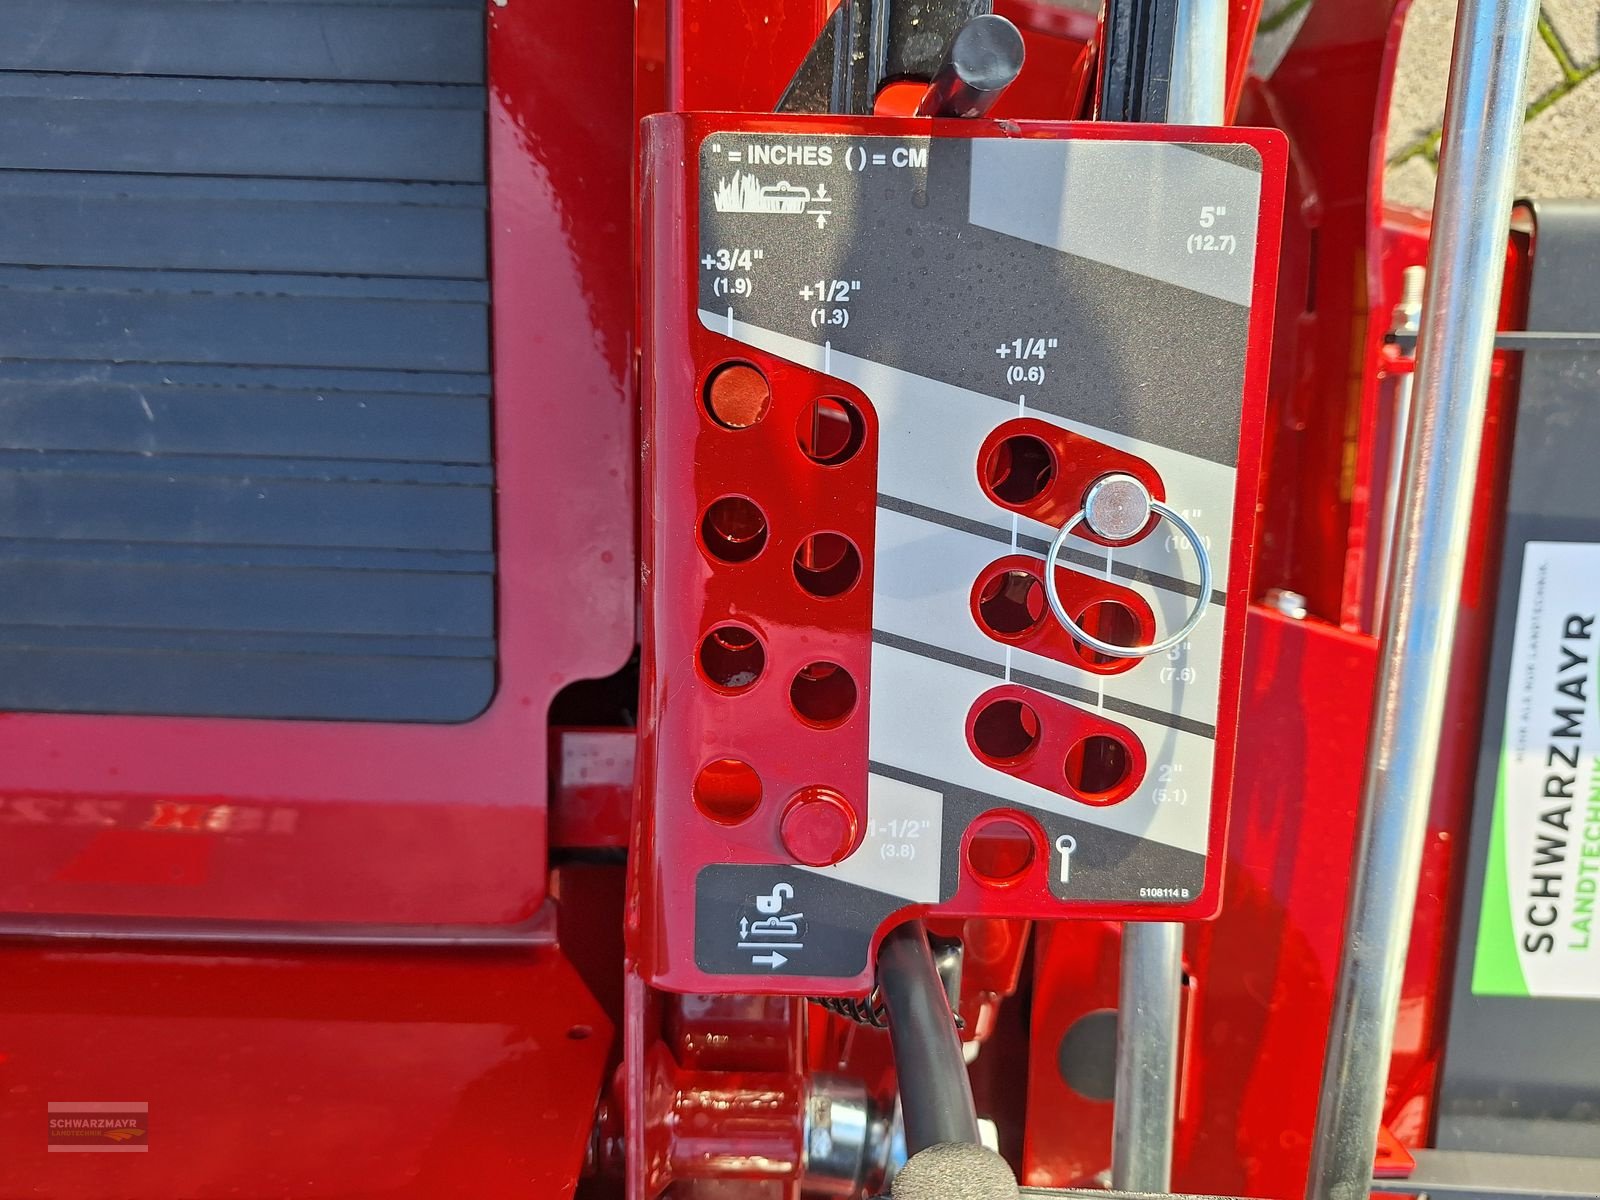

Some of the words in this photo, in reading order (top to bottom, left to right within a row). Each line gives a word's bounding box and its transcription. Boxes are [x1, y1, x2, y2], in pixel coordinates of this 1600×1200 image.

[748, 145, 833, 166] INCHES
[892, 148, 928, 168] CM
[1199, 206, 1226, 228] 5"
[1187, 234, 1236, 255] (12.7)
[701, 249, 764, 271] +3/4"
[713, 277, 752, 297] (1.9)
[799, 280, 861, 302] +1/2"
[811, 308, 849, 328] (1.3)
[995, 338, 1058, 360] +1/4"
[1006, 365, 1045, 385] (0.6)
[1166, 642, 1191, 661] 3"
[1159, 667, 1196, 685] (7.6)
[1158, 764, 1182, 782] 2"
[1523, 614, 1596, 953] SCHWARZMAYR
[1151, 788, 1187, 805] (5.1)
[868, 819, 930, 839] 1-1/2"
[880, 843, 916, 861] (3.8)
[1139, 887, 1180, 898] 5108114
[1181, 888, 1190, 898] B
